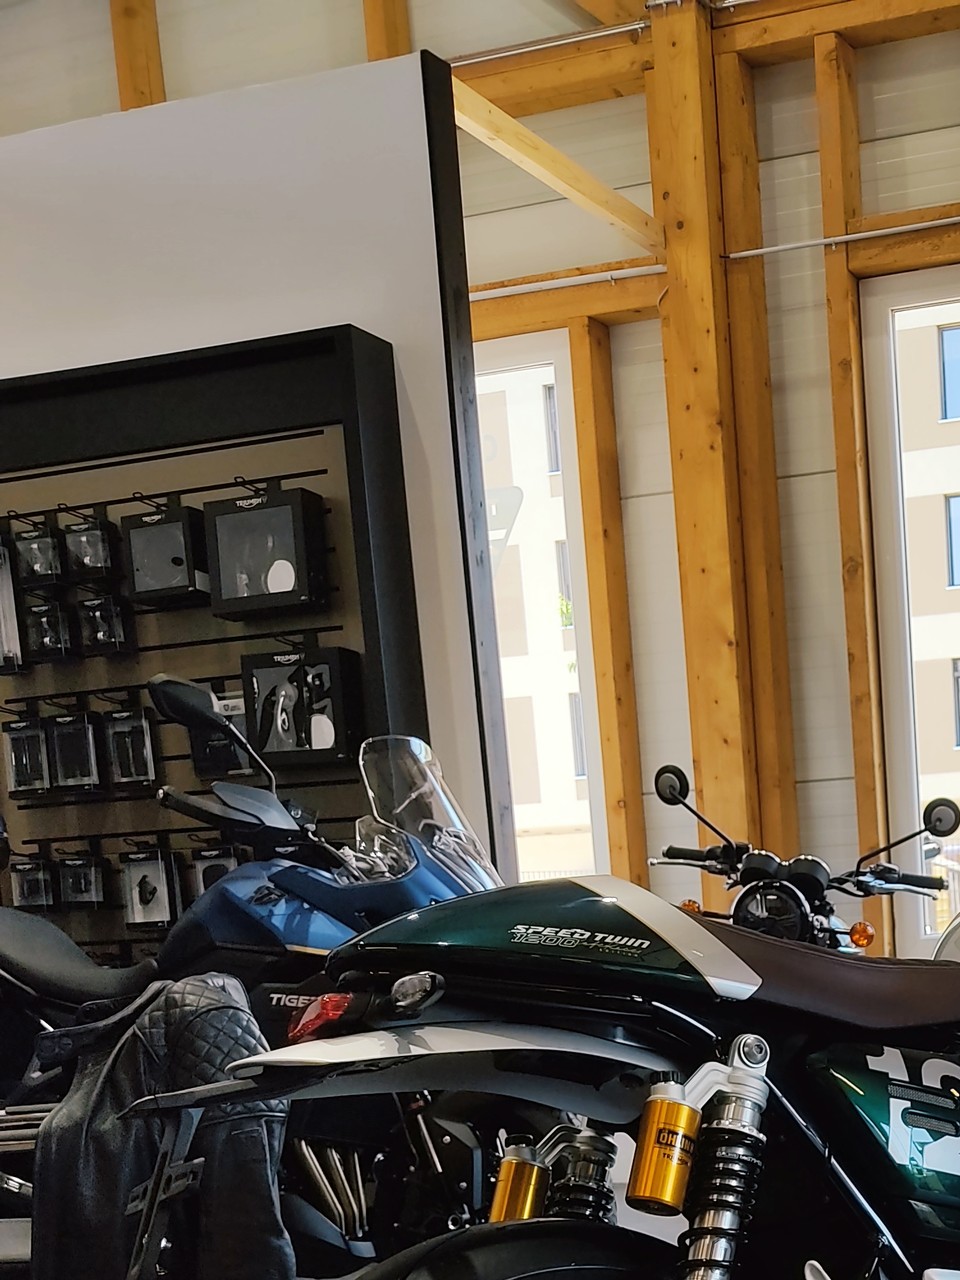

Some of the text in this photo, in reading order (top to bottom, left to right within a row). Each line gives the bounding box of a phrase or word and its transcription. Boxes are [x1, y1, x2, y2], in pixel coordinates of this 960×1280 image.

[508, 924, 592, 939] SPEED
[594, 932, 651, 949] TWIN
[511, 931, 580, 948] 1200
[269, 993, 319, 1008] TIGE
